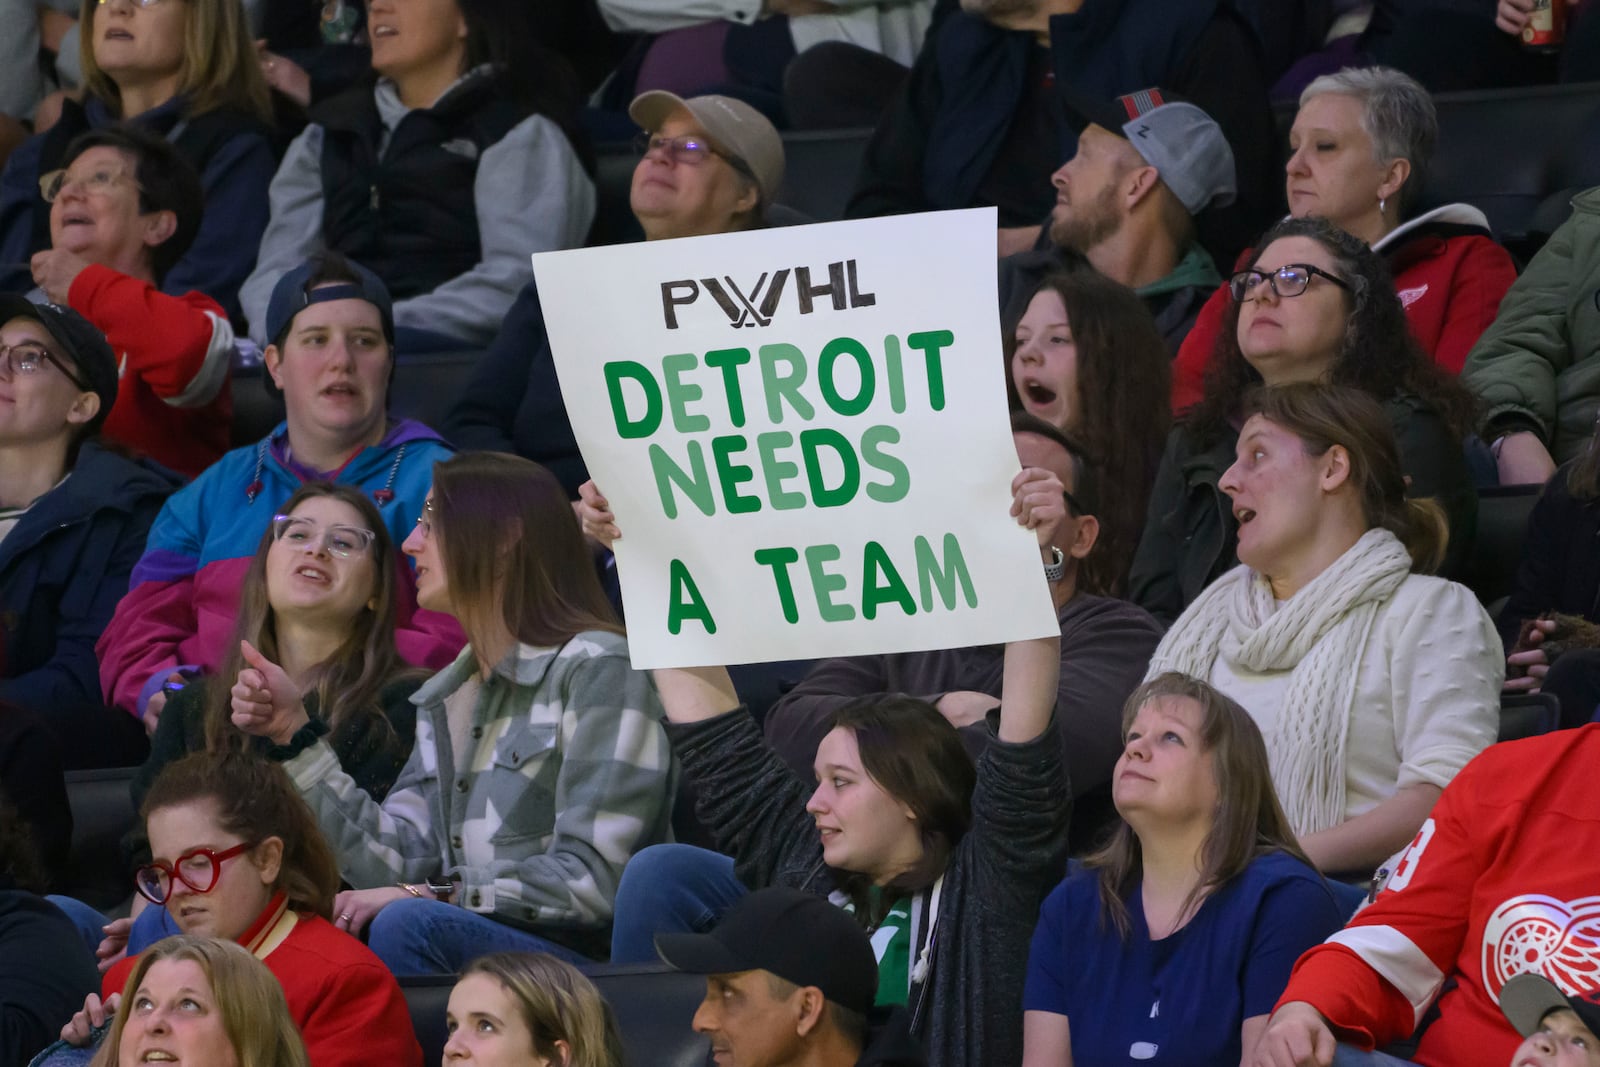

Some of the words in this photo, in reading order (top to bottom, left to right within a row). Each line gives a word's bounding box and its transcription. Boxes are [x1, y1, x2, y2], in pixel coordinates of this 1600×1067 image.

[660, 259, 876, 330] PWHL
[603, 329, 955, 439] DETROIT
[648, 425, 911, 519] NEEDS
[667, 558, 717, 636] A
[754, 533, 978, 625] TEAM
